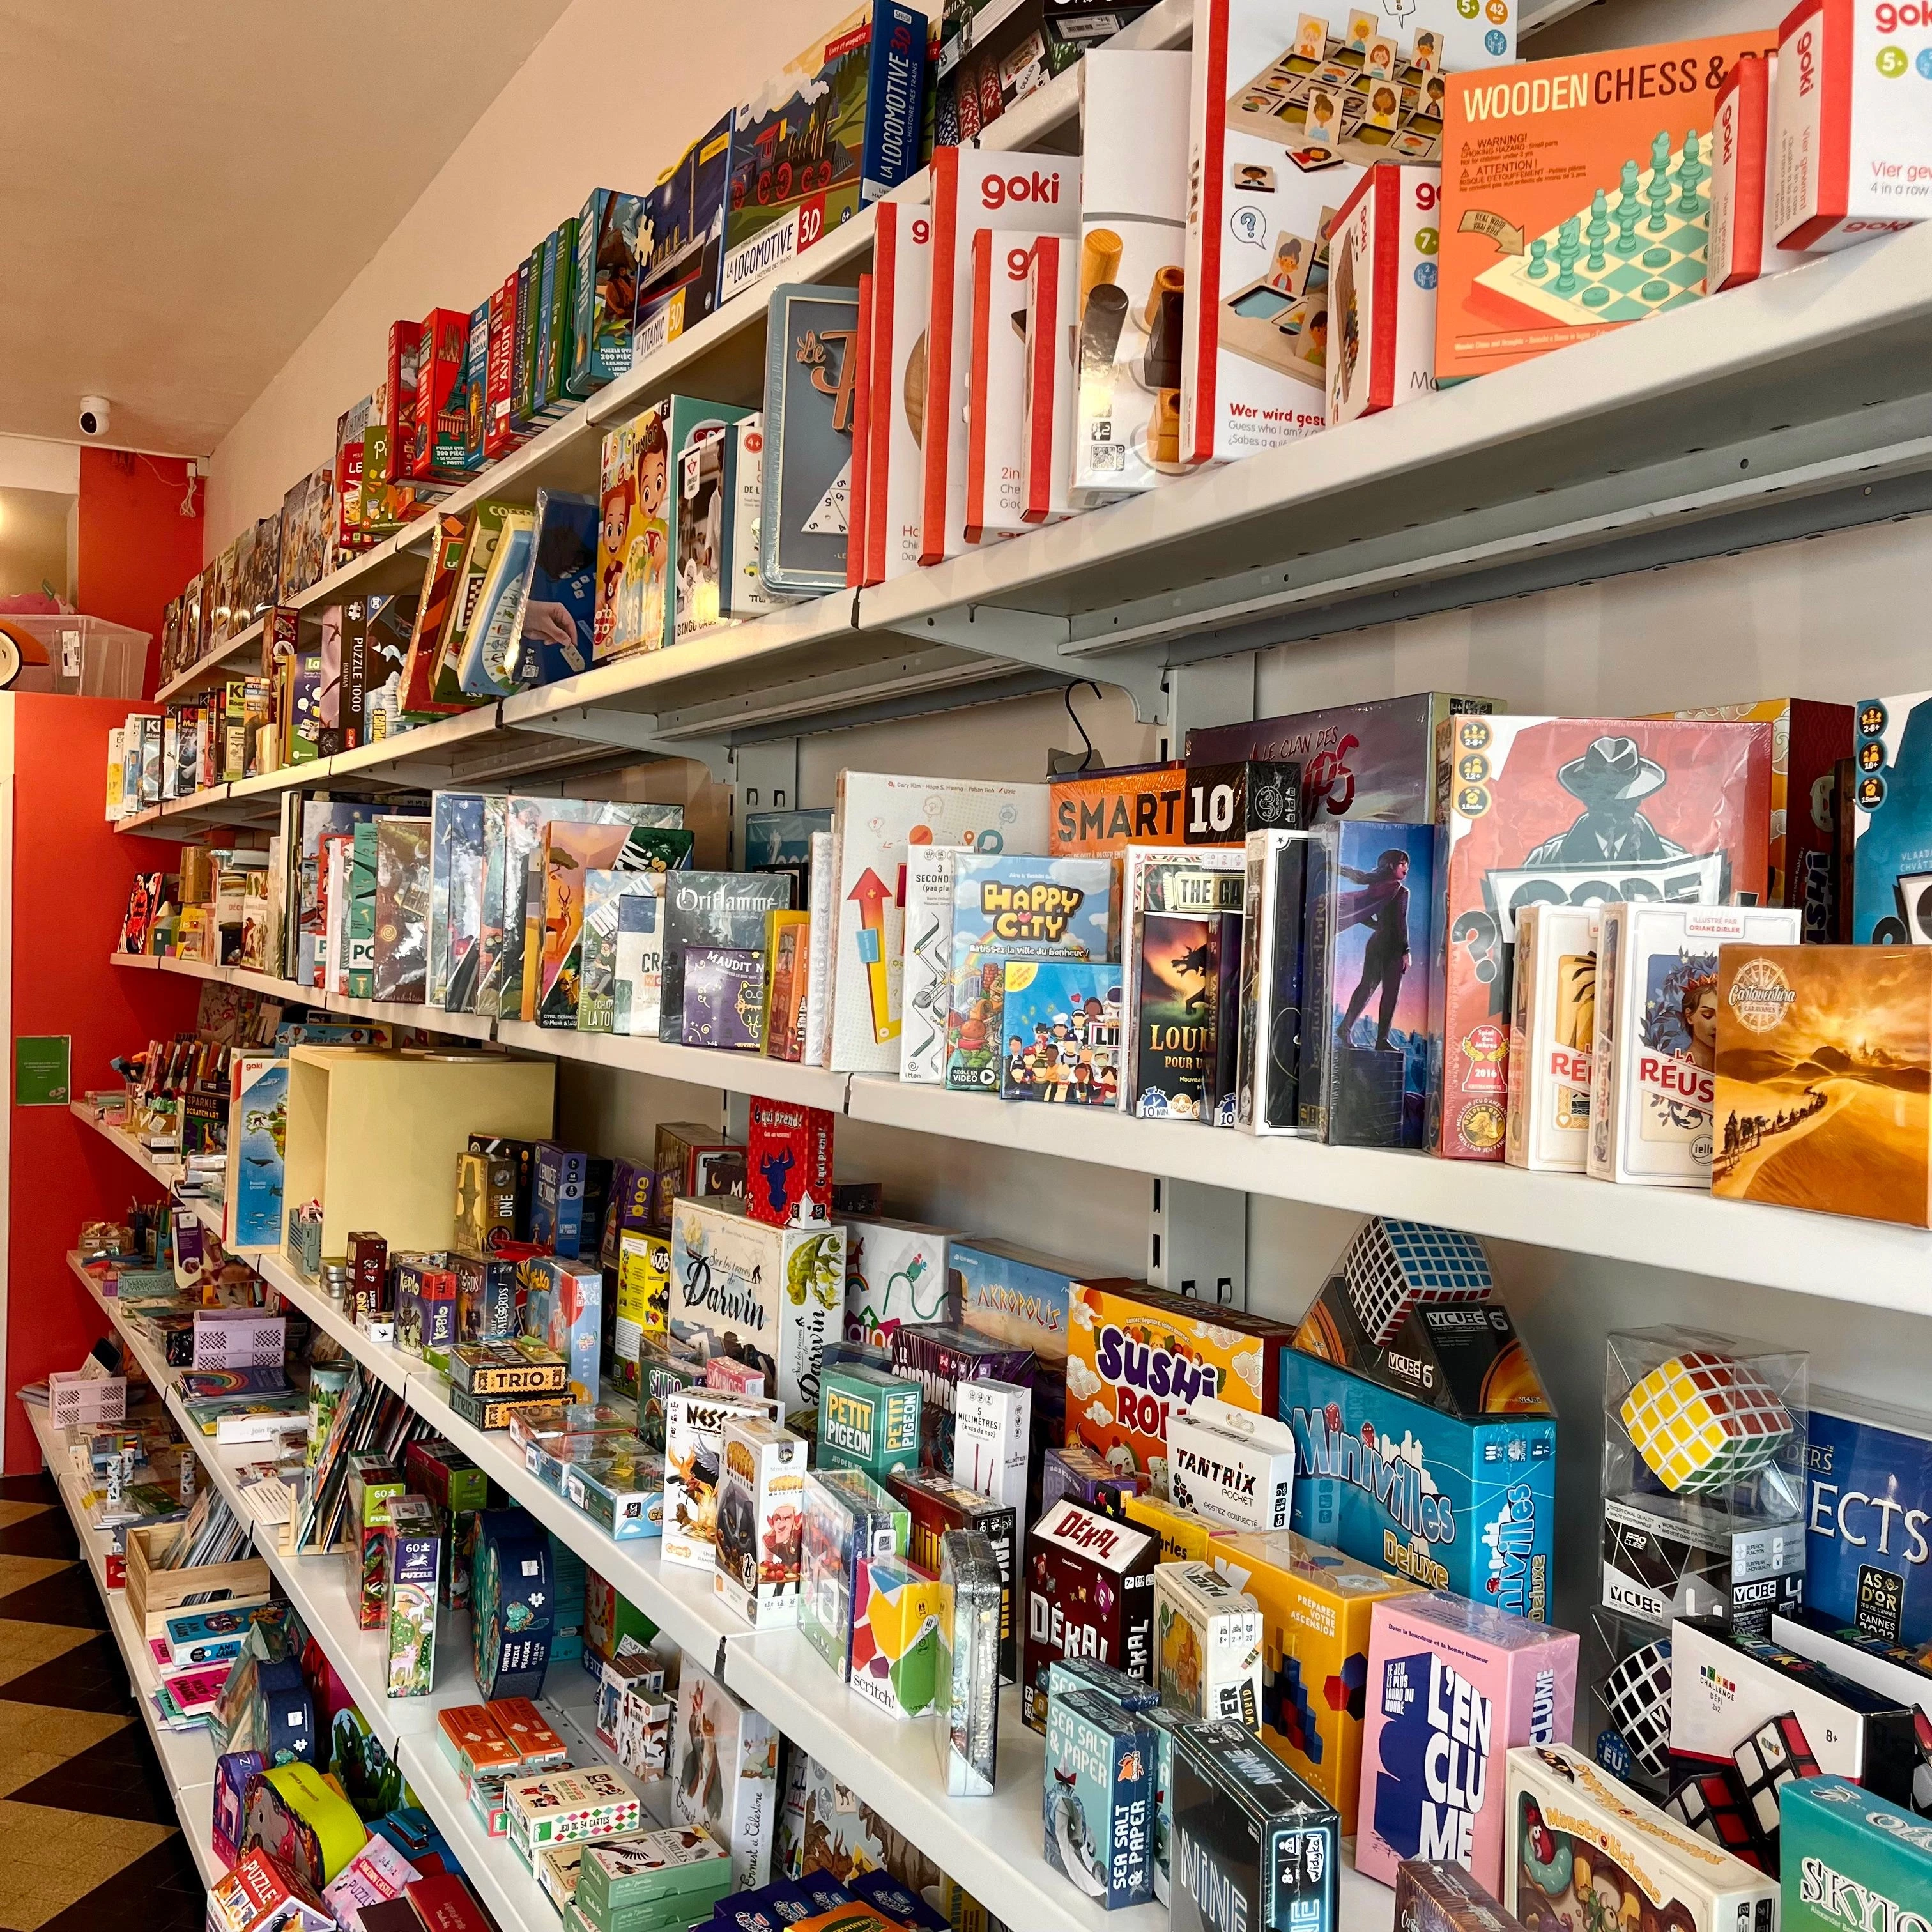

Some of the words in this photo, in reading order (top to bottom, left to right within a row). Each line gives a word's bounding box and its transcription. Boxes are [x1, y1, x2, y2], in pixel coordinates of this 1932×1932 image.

[891, 27, 911, 53] 3D
[1020, 64, 1036, 89] DEALER
[1797, 31, 1814, 98] goki
[1594, 59, 1698, 104] CHESS
[1705, 56, 1729, 89] &
[890, 52, 909, 166] LOCOMOTIVE
[1464, 72, 1588, 123] WOODEN
[1478, 133, 1527, 148] WARNING!
[1722, 105, 1733, 165] goki
[1460, 146, 1494, 159] CHOKING
[1496, 144, 1525, 154] HAZARD
[880, 164, 893, 180] LA
[1476, 161, 1532, 176] ATTENTION
[1871, 161, 1903, 178] Vier
[981, 171, 1059, 210] goki
[1871, 182, 1878, 192] 4
[1881, 182, 1892, 194] in
[1894, 185, 1903, 194] a
[1905, 185, 1928, 197] row
[801, 208, 820, 243] 3D
[1360, 204, 1370, 253] goki
[727, 261, 733, 278] LA
[734, 223, 793, 284] LOCOMOTIVE
[670, 302, 682, 332] 3D
[641, 316, 665, 356] TITANIC
[499, 325, 511, 392] L'AVION
[1230, 403, 1258, 417] Wer
[1263, 409, 1292, 422] wird
[1229, 420, 1255, 432] Guess
[1258, 425, 1276, 434] who
[1228, 434, 1259, 445] ¿Sabes
[353, 636, 364, 681] PUZZLE
[351, 683, 362, 713] 1000
[1864, 724, 1880, 733] 2-8+
[1280, 736, 1311, 758] CLAN
[1316, 726, 1338, 750] DES
[1864, 762, 1878, 770] 10+
[1057, 790, 1181, 843] SMART
[1189, 784, 1234, 833] 10
[916, 875, 949, 883] SECOND
[923, 884, 937, 893] (pas
[1181, 878, 1211, 904] THE
[675, 887, 776, 912] Oriflamme
[984, 884, 1079, 914] HAPPY
[707, 951, 753, 974] MAUDIT
[1016, 946, 1034, 954] ville
[1036, 947, 1046, 956] du
[1049, 948, 1084, 957] bonheur
[1728, 983, 1797, 1006] Cartaventura
[588, 1013, 599, 1027] LA
[246, 1062, 263, 1070] goki
[1165, 1056, 1193, 1069] POUR
[1675, 1048, 1694, 1064] LA
[1475, 1068, 1497, 1078] 2016
[187, 1094, 217, 1109] SPARKLE
[1143, 1107, 1155, 1118] 10
[761, 1110, 773, 1126] qui
[774, 1110, 802, 1128] prend!
[818, 1128, 826, 1160] prend!
[818, 1163, 827, 1180] qui
[500, 1194, 513, 1217] ONE
[685, 1256, 765, 1331] Darwin
[977, 1284, 1065, 1333] AKROPOLIS
[1489, 1311, 1508, 1331] 6
[899, 1347, 908, 1363] LE
[496, 1372, 544, 1388] TRIO
[1423, 1360, 1434, 1388] 6
[827, 1393, 871, 1423] PETIT
[887, 1397, 903, 1450] PETIT
[902, 1394, 917, 1449] PIGEON
[827, 1423, 871, 1457] PIGEON
[1293, 1407, 1457, 1544] Minivilles
[374, 1490, 388, 1499] 60
[1222, 1489, 1254, 1506] POCKET
[1204, 1501, 1225, 1517] RESTEZ
[1227, 1508, 1259, 1527] CONNECTÉ
[1053, 1510, 1120, 1560] DÉKAL
[1624, 1539, 1645, 1551] CUBE
[1626, 1532, 1647, 1544] PRO
[406, 1543, 420, 1553] 60
[1383, 1528, 1450, 1590] Deluxe
[400, 1570, 433, 1579] PUZZLE
[1863, 1571, 1882, 1588] AS
[1298, 1594, 1336, 1619] PRÉPAREZ
[1862, 1586, 1897, 1612] D'OR
[1291, 1611, 1335, 1638] ASCENSION
[1310, 1609, 1335, 1629] VOTRE
[1388, 1623, 1402, 1633] Dans
[1860, 1613, 1895, 1631] CANNES
[502, 1643, 512, 1673] CONTOUR
[511, 1645, 521, 1667] PUZZLE
[521, 1641, 531, 1669] PEACOCK
[1387, 1664, 1393, 1676] LE
[1393, 1662, 1406, 1676] JEU
[853, 1675, 894, 1710] scritch!
[1386, 1675, 1393, 1687] LE
[1394, 1675, 1408, 1688] PLUS
[1699, 1676, 1735, 1702] CHALLENGE
[1386, 1687, 1404, 1703] LOURD
[1406, 1688, 1414, 1702] DU
[1427, 1652, 1492, 1756] L'EN
[1710, 1692, 1723, 1705] DÉFI
[1242, 1689, 1254, 1726] WORLD
[1384, 1700, 1405, 1715] MONDE
[1712, 1703, 1721, 1713] 2x2
[975, 1684, 992, 1759] Saboteur
[1050, 1705, 1074, 1735] SEA
[1078, 1721, 1108, 1754] SALT
[1826, 1729, 1839, 1742] 8+
[1050, 1729, 1060, 1755] &
[1064, 1743, 1108, 1788] PAPER
[1603, 1750, 1623, 1770] EU
[1424, 1732, 1487, 1814] CLU
[590, 1816, 610, 1827] CARTES
[1113, 1804, 1130, 1850] SALT
[1129, 1800, 1146, 1865] PAPER
[1420, 1800, 1475, 1872] ME
[740, 1848, 759, 1889] Ernest
[1112, 1856, 1128, 1889] SEA
[1128, 1868, 1144, 1886] &
[245, 1860, 276, 1905] PUZZLE
[376, 1874, 395, 1897] CASTLE
